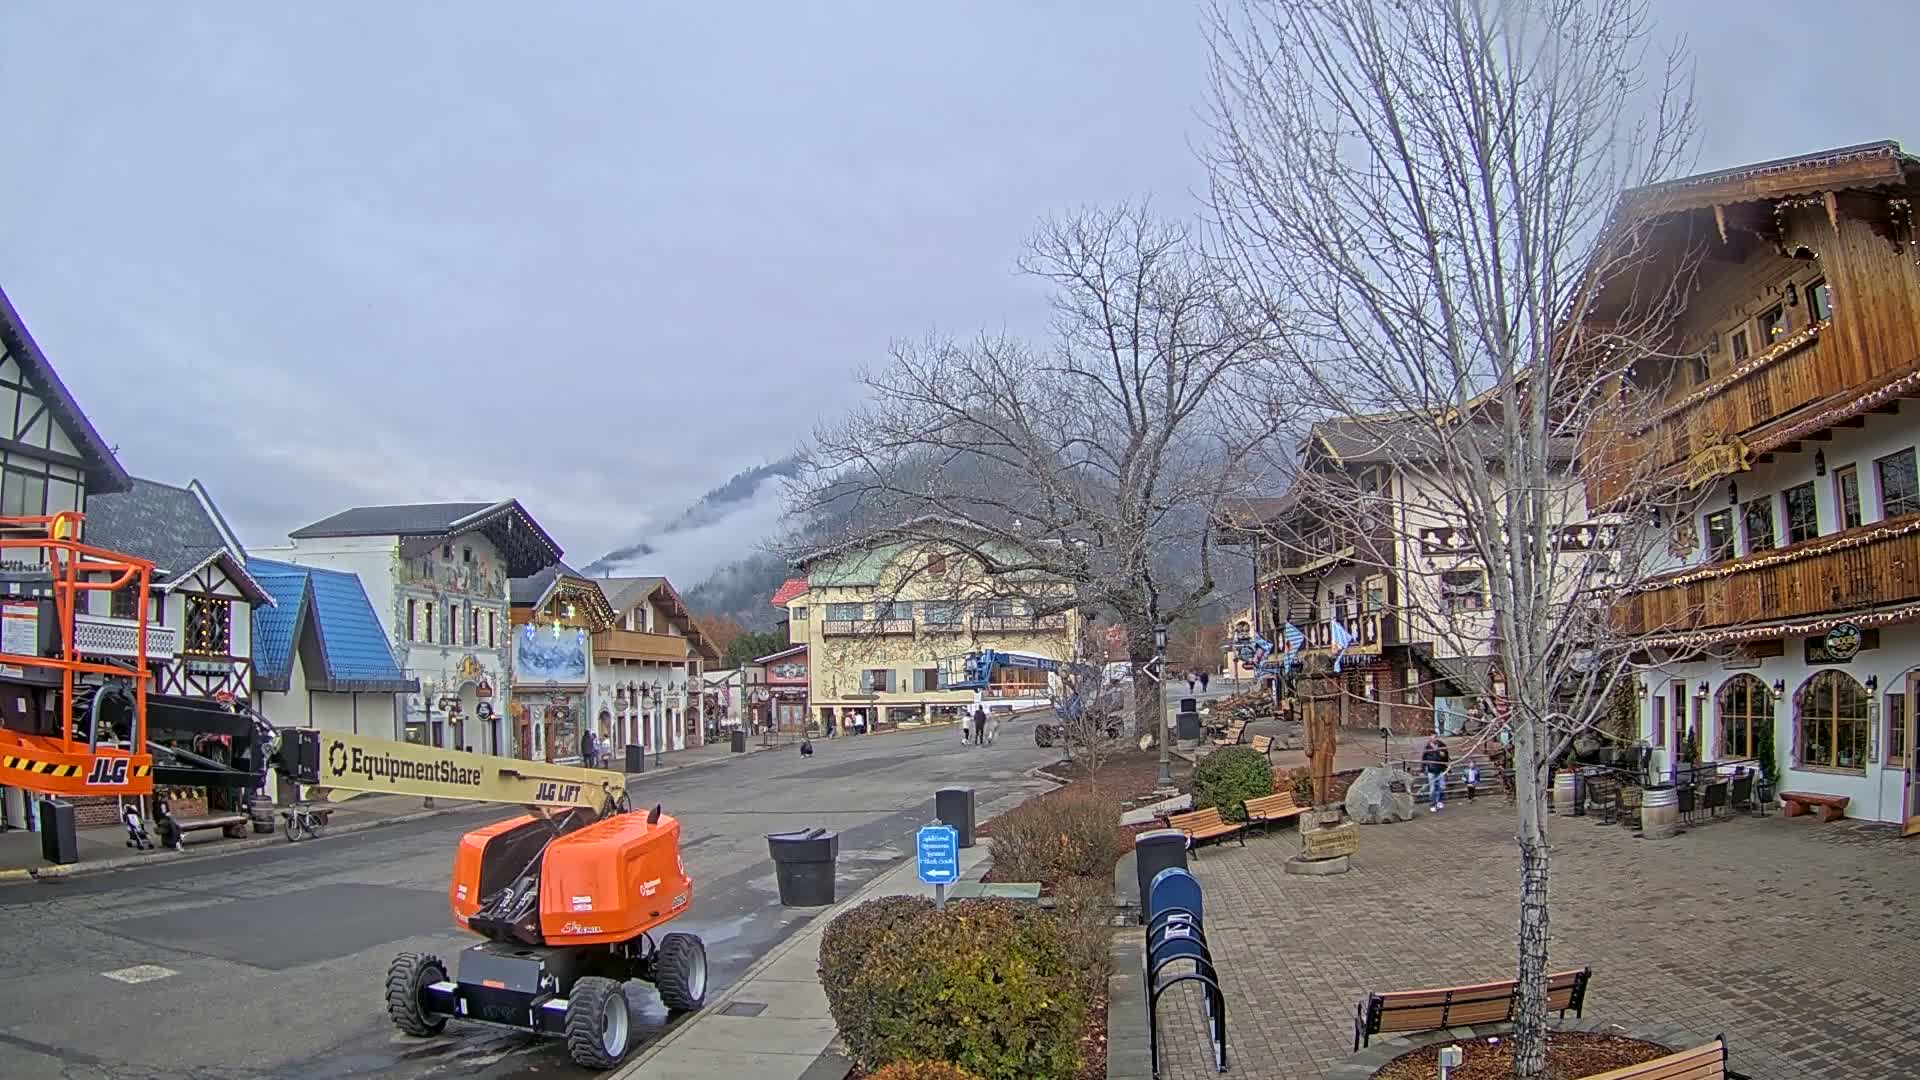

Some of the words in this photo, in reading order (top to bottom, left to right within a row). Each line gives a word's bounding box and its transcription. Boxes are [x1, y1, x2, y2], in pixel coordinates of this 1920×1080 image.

[87, 758, 130, 784] JLG
[351, 746, 481, 786] EquipmentShare
[536, 782, 556, 801] JLG
[558, 784, 581, 803] LIFT
